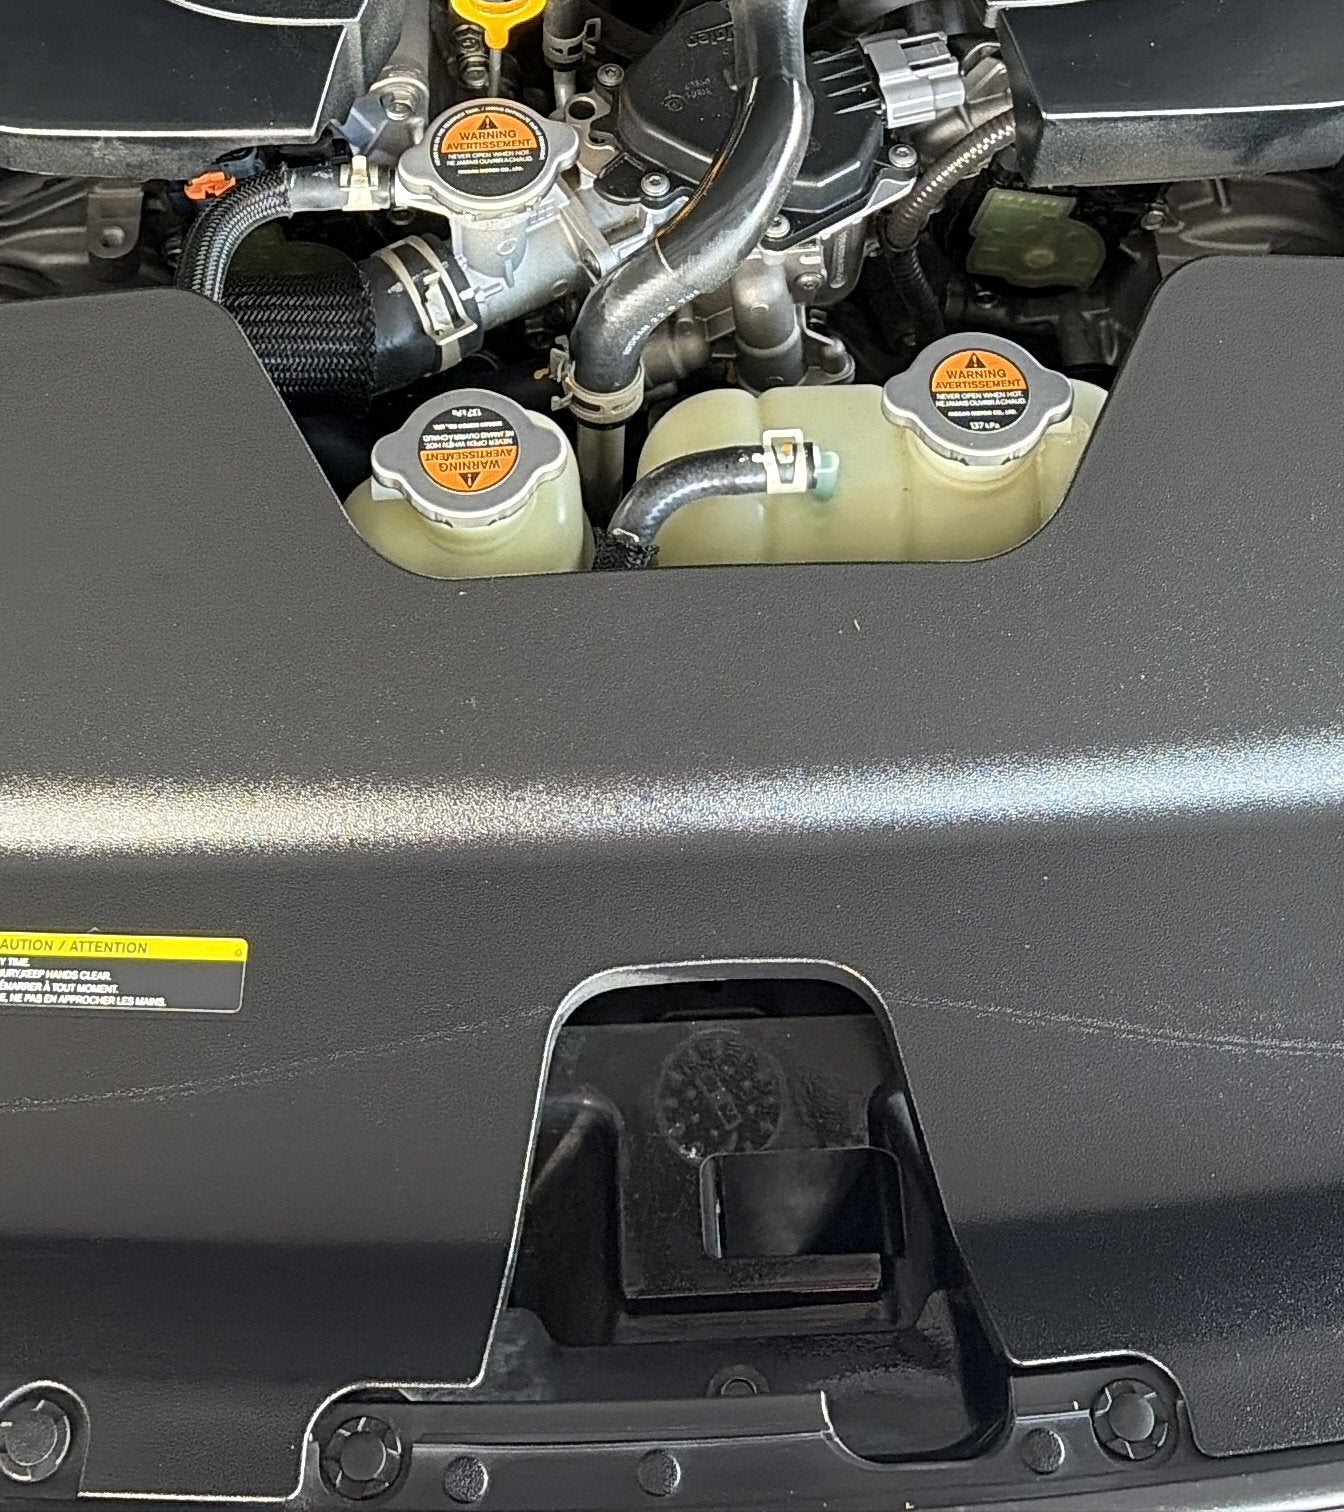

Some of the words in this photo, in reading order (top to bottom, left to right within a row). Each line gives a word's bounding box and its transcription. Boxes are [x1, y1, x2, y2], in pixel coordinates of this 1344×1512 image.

[459, 130, 517, 141] WARNING
[446, 138, 532, 151] AVERTISSEMENT
[448, 152, 471, 160] NEVER
[472, 151, 492, 159] OPEN
[493, 150, 515, 158] WHEN
[946, 368, 1007, 379] WARNING
[936, 378, 1022, 389] AVERTISSEMENT
[936, 392, 960, 400] NEVER
[961, 391, 983, 399] OPEN
[467, 408, 483, 418] 137
[969, 421, 984, 430] 137
[984, 420, 1001, 430] kPa
[442, 440, 466, 448] WHEN
[467, 439, 488, 447] OPEN
[424, 448, 513, 462] AVERTISSEMENT
[438, 459, 501, 472] WARNING
[58, 939, 68, 951] /
[69, 940, 148, 954] ATTENTION
[8, 957, 31, 967] TIME.
[45, 970, 78, 980] HANDS
[79, 970, 112, 981] CLEAR.
[42, 979, 51, 992] À
[51, 982, 77, 992] TOUT
[76, 983, 119, 994] MOMENT.
[9, 993, 23, 1003] NE
[23, 993, 43, 1003] PAS
[43, 994, 58, 1004] EN
[57, 994, 116, 1005] APPROCHER
[116, 996, 135, 1006] LES
[135, 996, 167, 1007] MAINS.
